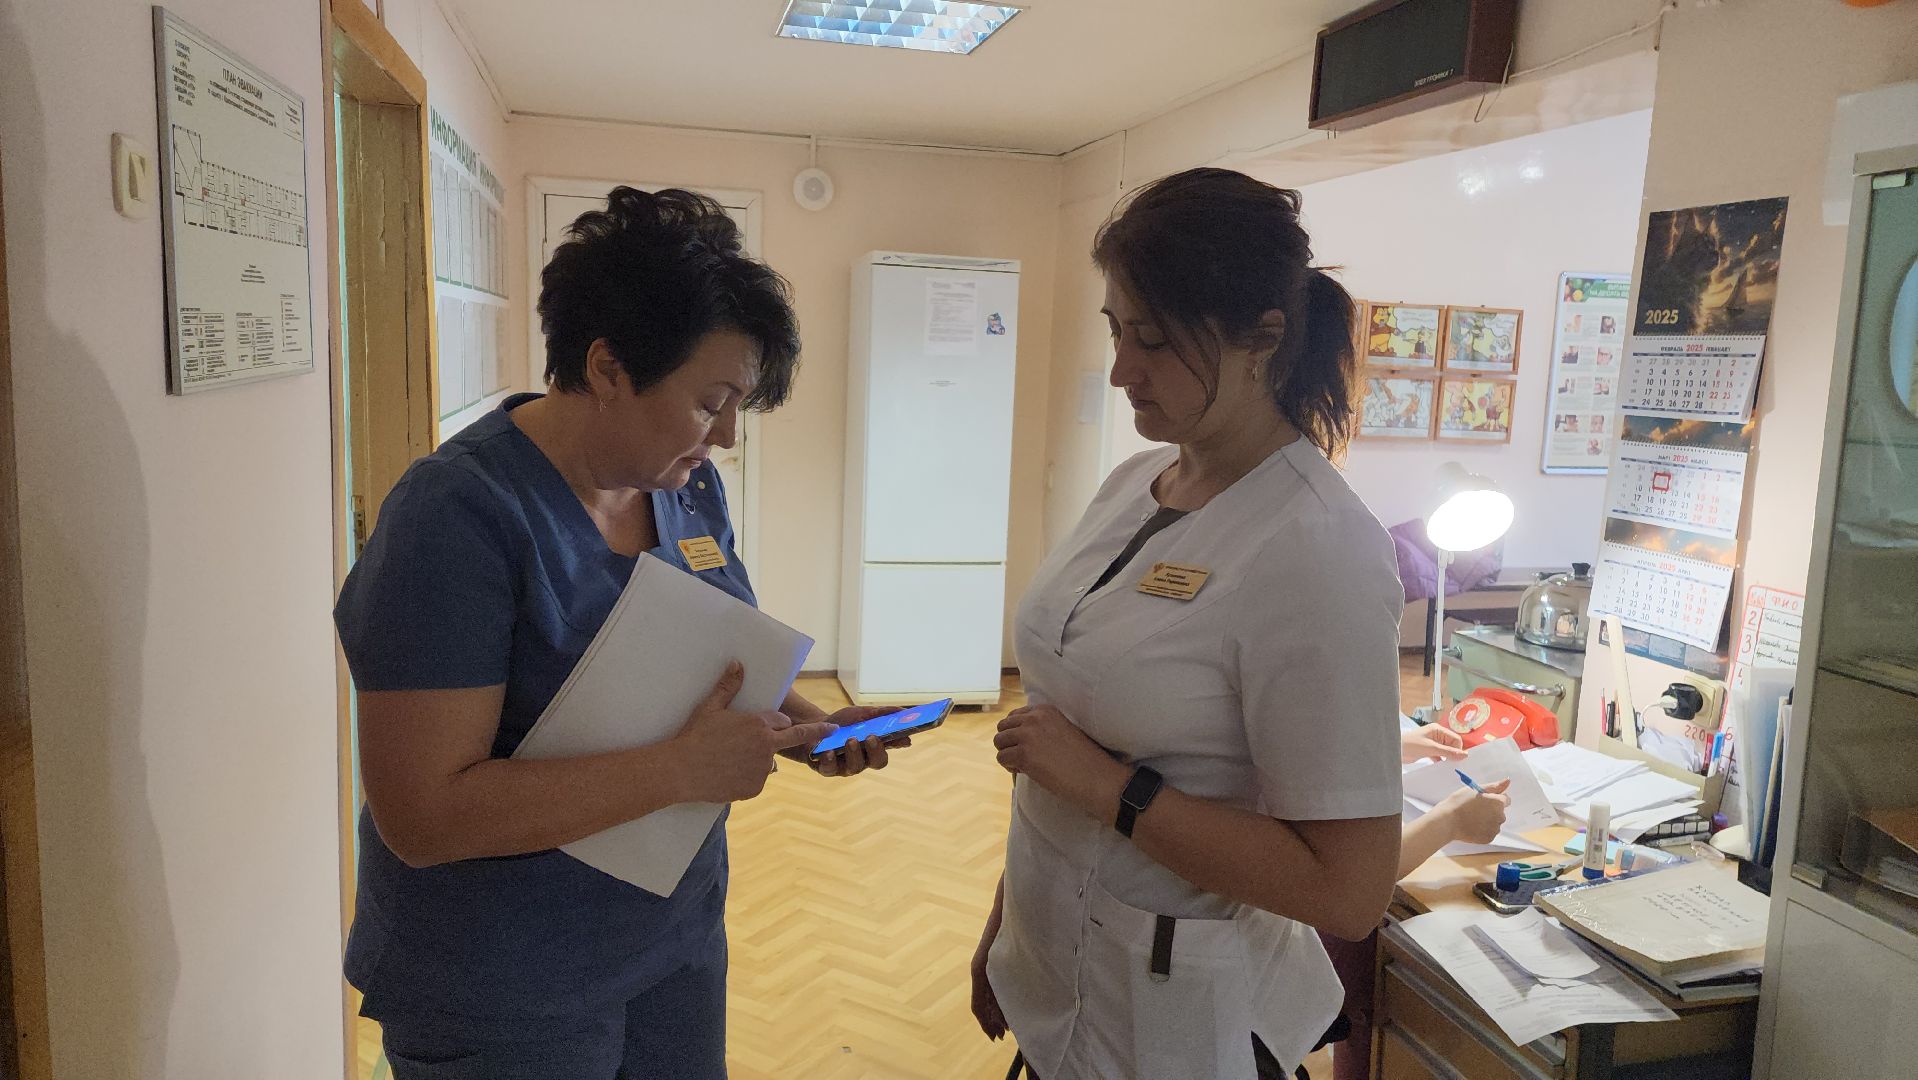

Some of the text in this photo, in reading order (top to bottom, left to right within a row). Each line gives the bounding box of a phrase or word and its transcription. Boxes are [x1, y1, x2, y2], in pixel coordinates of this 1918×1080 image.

[1645, 309, 1679, 325] 2025
[1673, 455, 1688, 463] 2025
[1658, 562, 1676, 571] 2025
[1748, 611, 1757, 625] 2
[1742, 634, 1751, 653] 3
[1684, 724, 1705, 741] 220
[1725, 726, 1733, 740] 6
